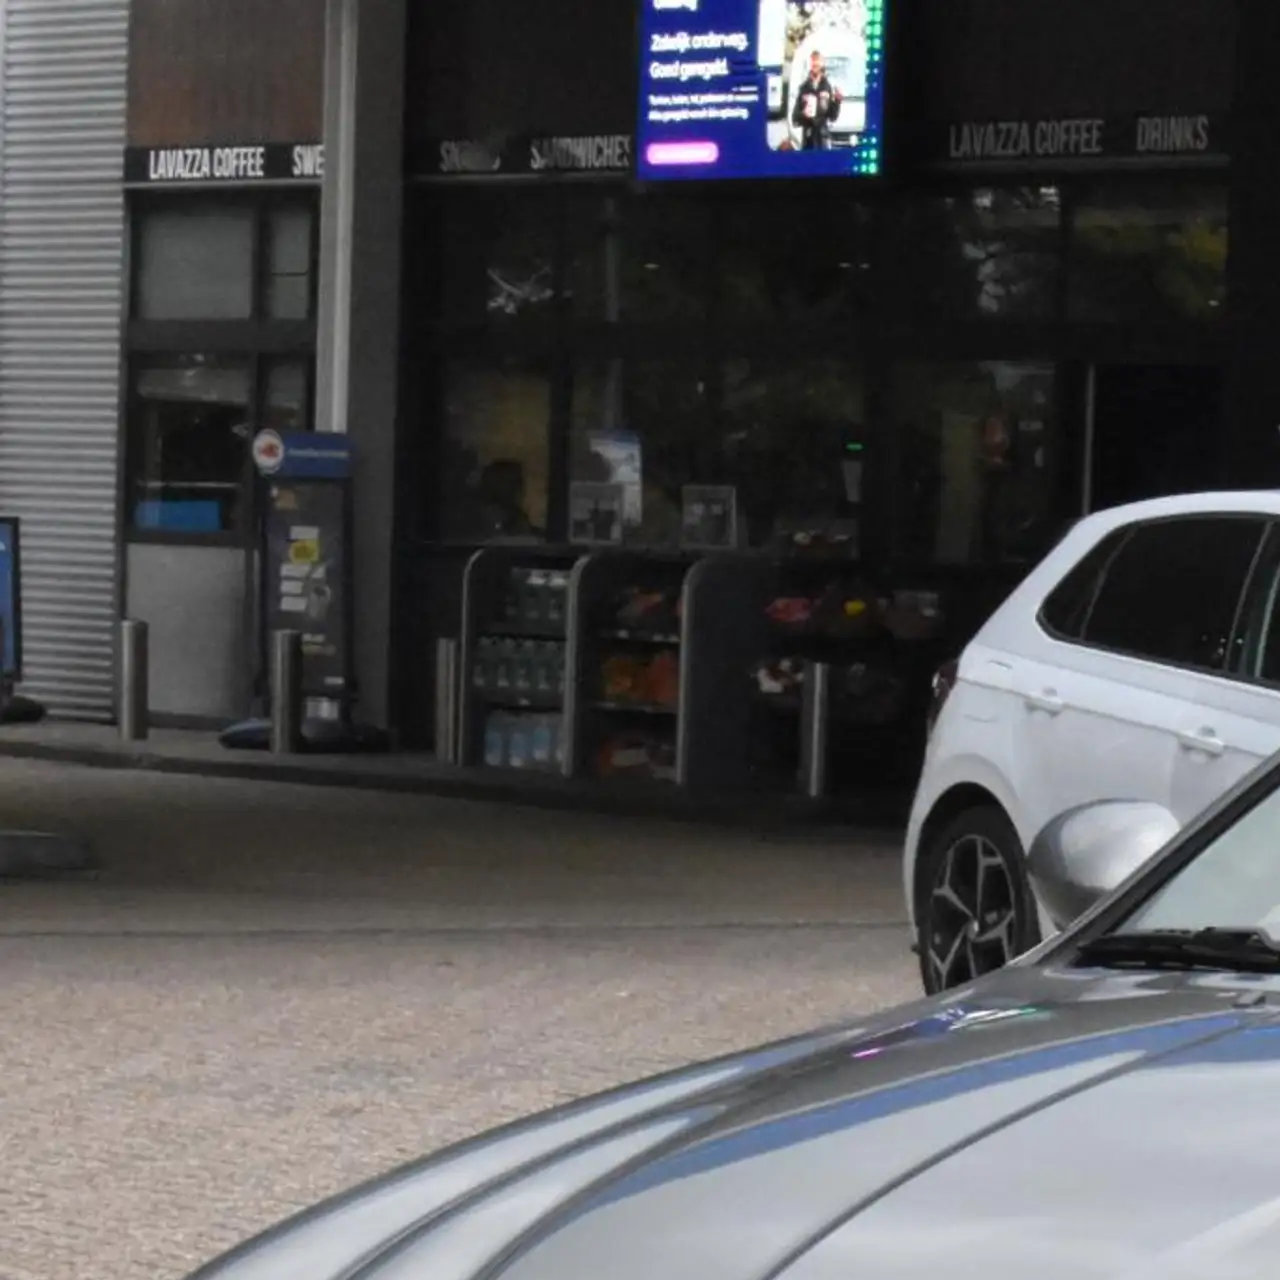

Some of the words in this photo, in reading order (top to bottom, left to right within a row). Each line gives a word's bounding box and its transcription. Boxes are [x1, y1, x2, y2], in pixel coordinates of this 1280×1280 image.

[949, 121, 1030, 157] LAVAZZA
[1034, 119, 1105, 155] COFFEE
[1136, 115, 1210, 152] DRINKS
[149, 148, 211, 180] LAVAZZA
[213, 146, 265, 178] COFFEE
